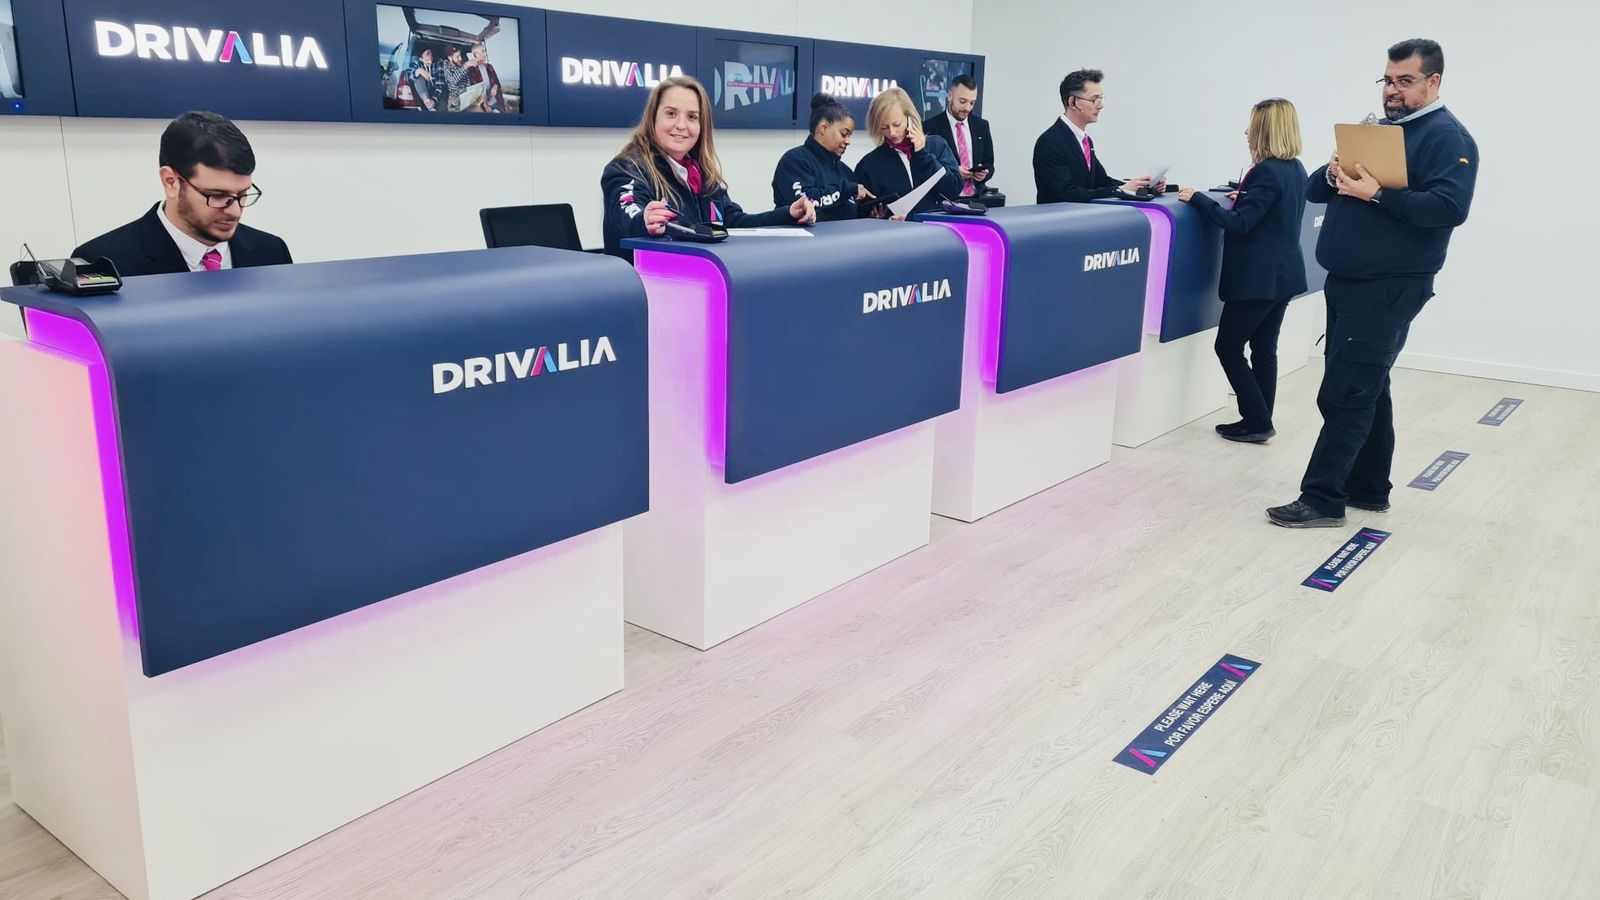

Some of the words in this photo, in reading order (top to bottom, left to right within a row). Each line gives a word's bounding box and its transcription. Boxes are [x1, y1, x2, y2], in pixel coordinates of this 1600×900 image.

[95, 20, 328, 70] DRIVALIA
[714, 60, 795, 111] RIVAL
[1083, 247, 1140, 272] DRIVALIA
[862, 278, 952, 314] DRIVALIA
[432, 336, 617, 394] DRIVALIA
[1154, 708, 1185, 732] PLEASE
[1178, 695, 1197, 711] WAIT
[1190, 681, 1213, 698] HERE
[1164, 731, 1186, 747] POR
[1177, 714, 1204, 735] FAVOR
[1197, 692, 1225, 716] ESPERE
